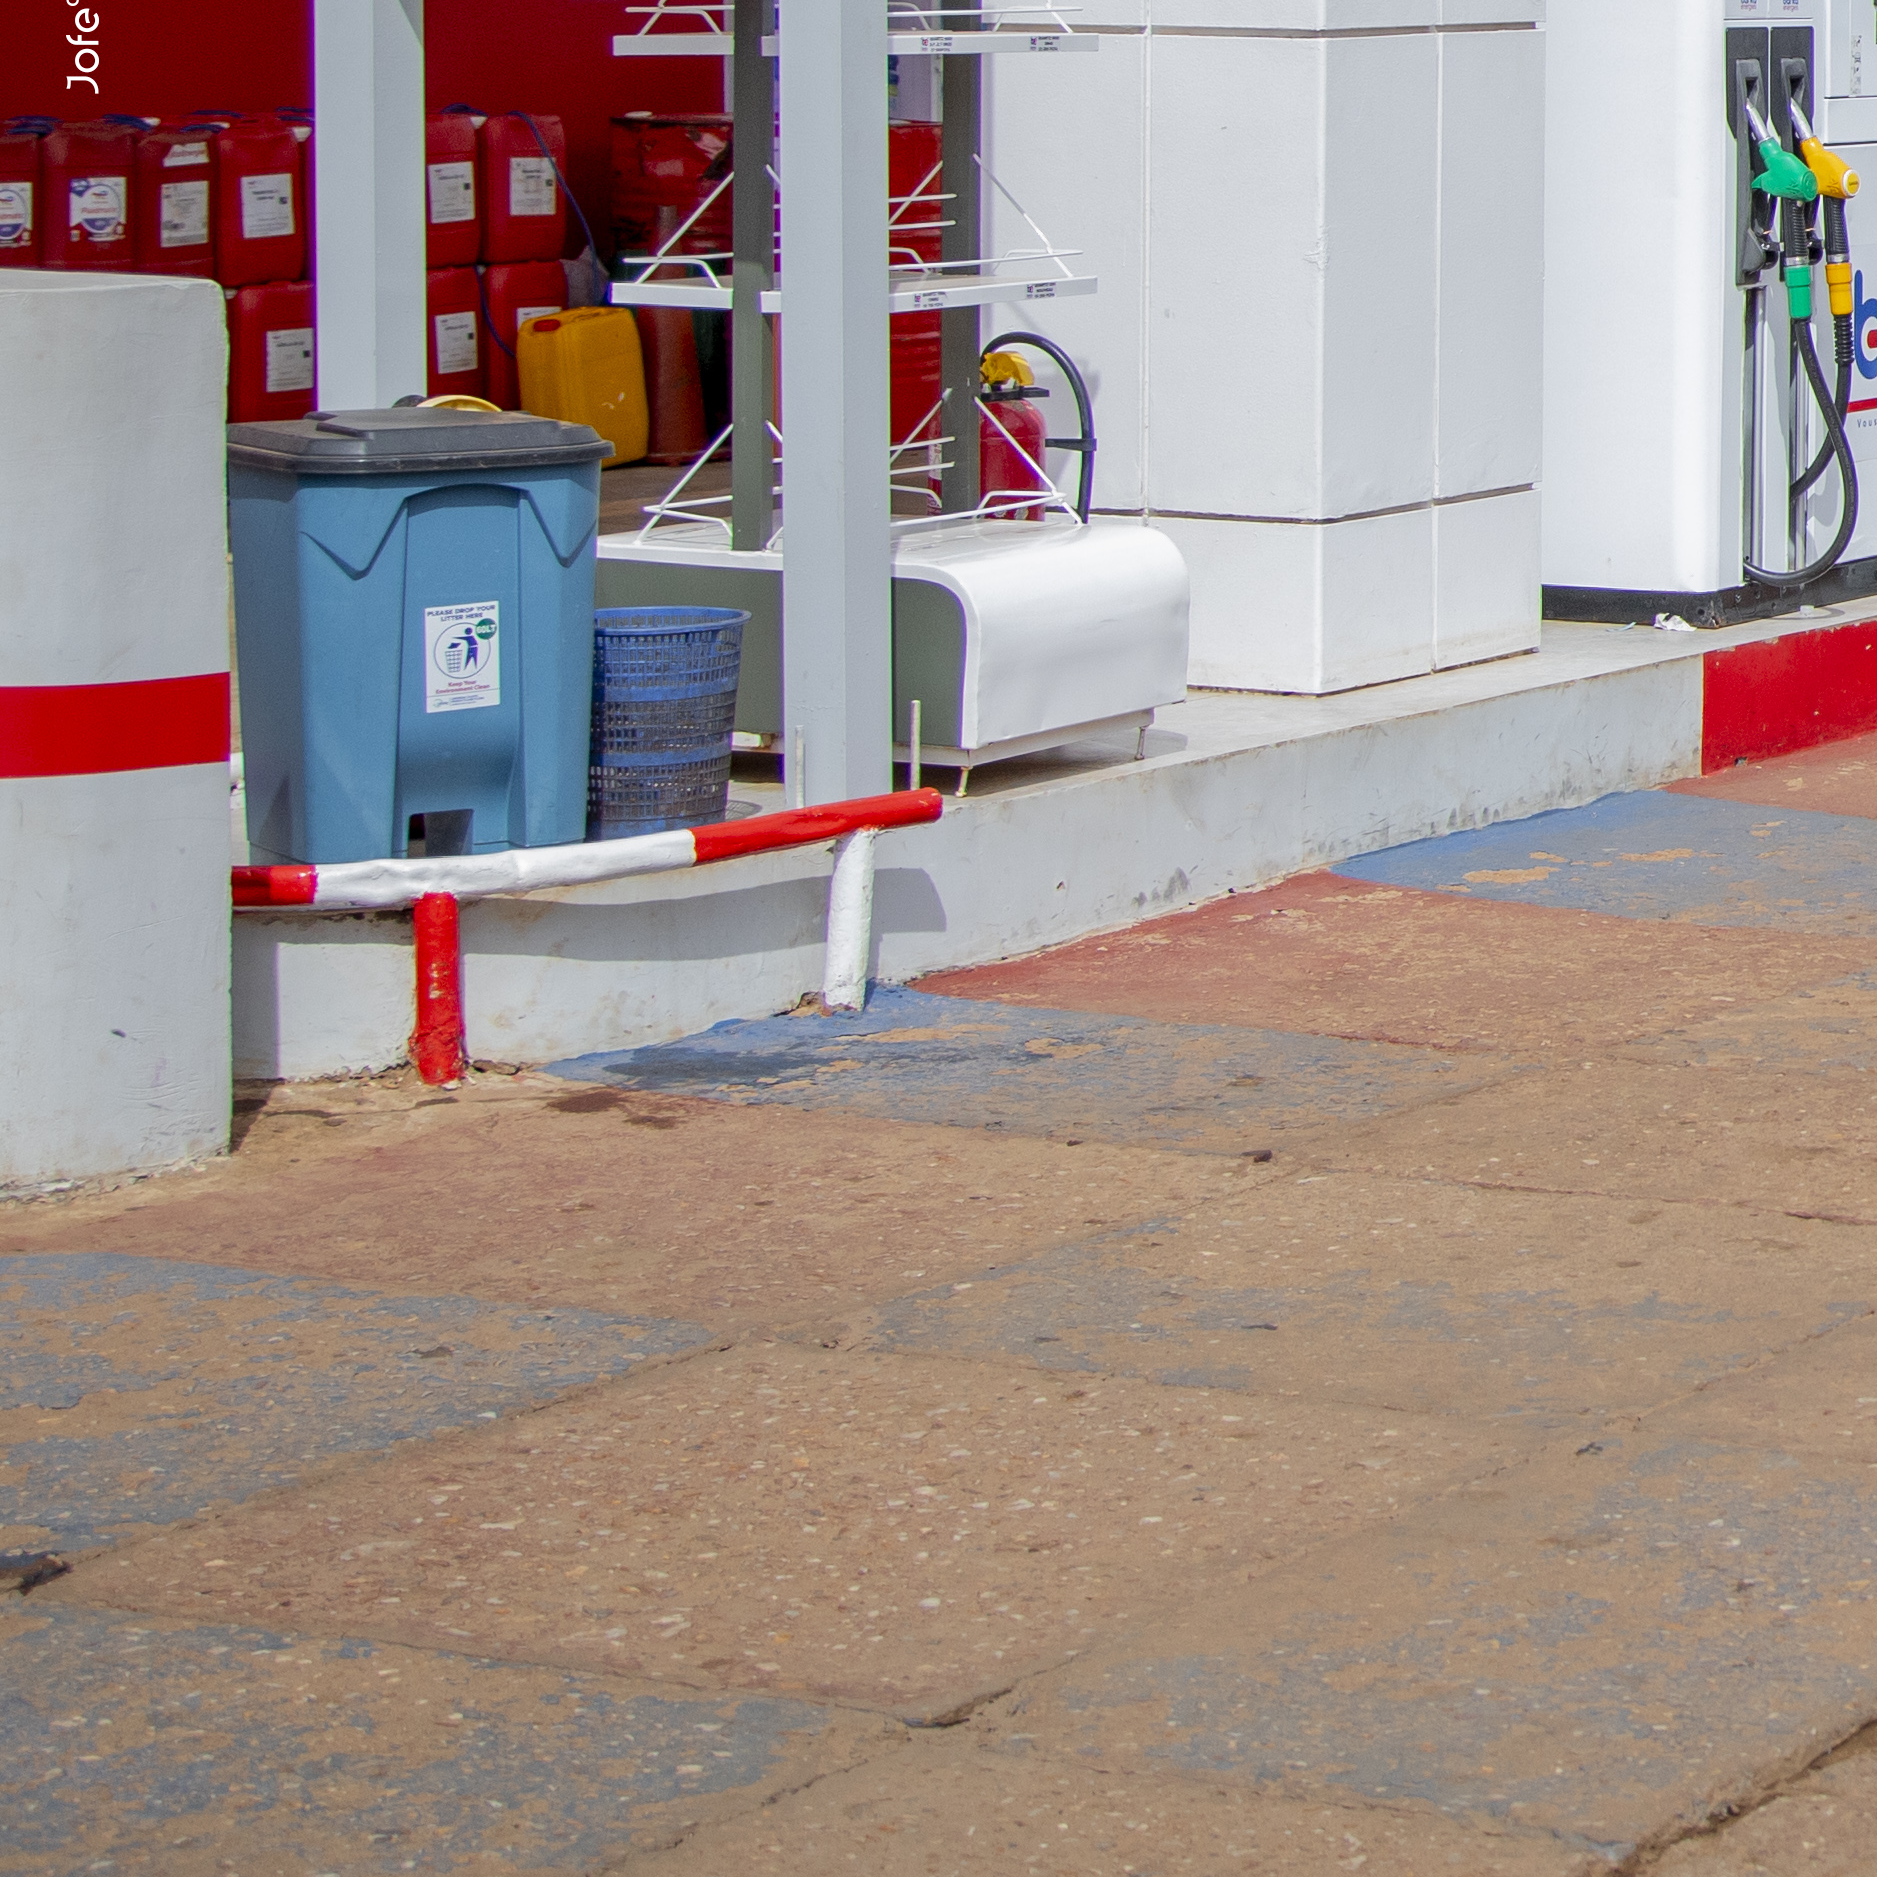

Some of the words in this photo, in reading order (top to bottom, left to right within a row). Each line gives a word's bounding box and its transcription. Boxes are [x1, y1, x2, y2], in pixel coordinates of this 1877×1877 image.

[1856, 417, 1877, 428] Vous
[427, 609, 453, 617] PLEASE
[454, 607, 475, 615] DROP
[440, 614, 464, 622] LITTER
[448, 681, 464, 689] Keep
